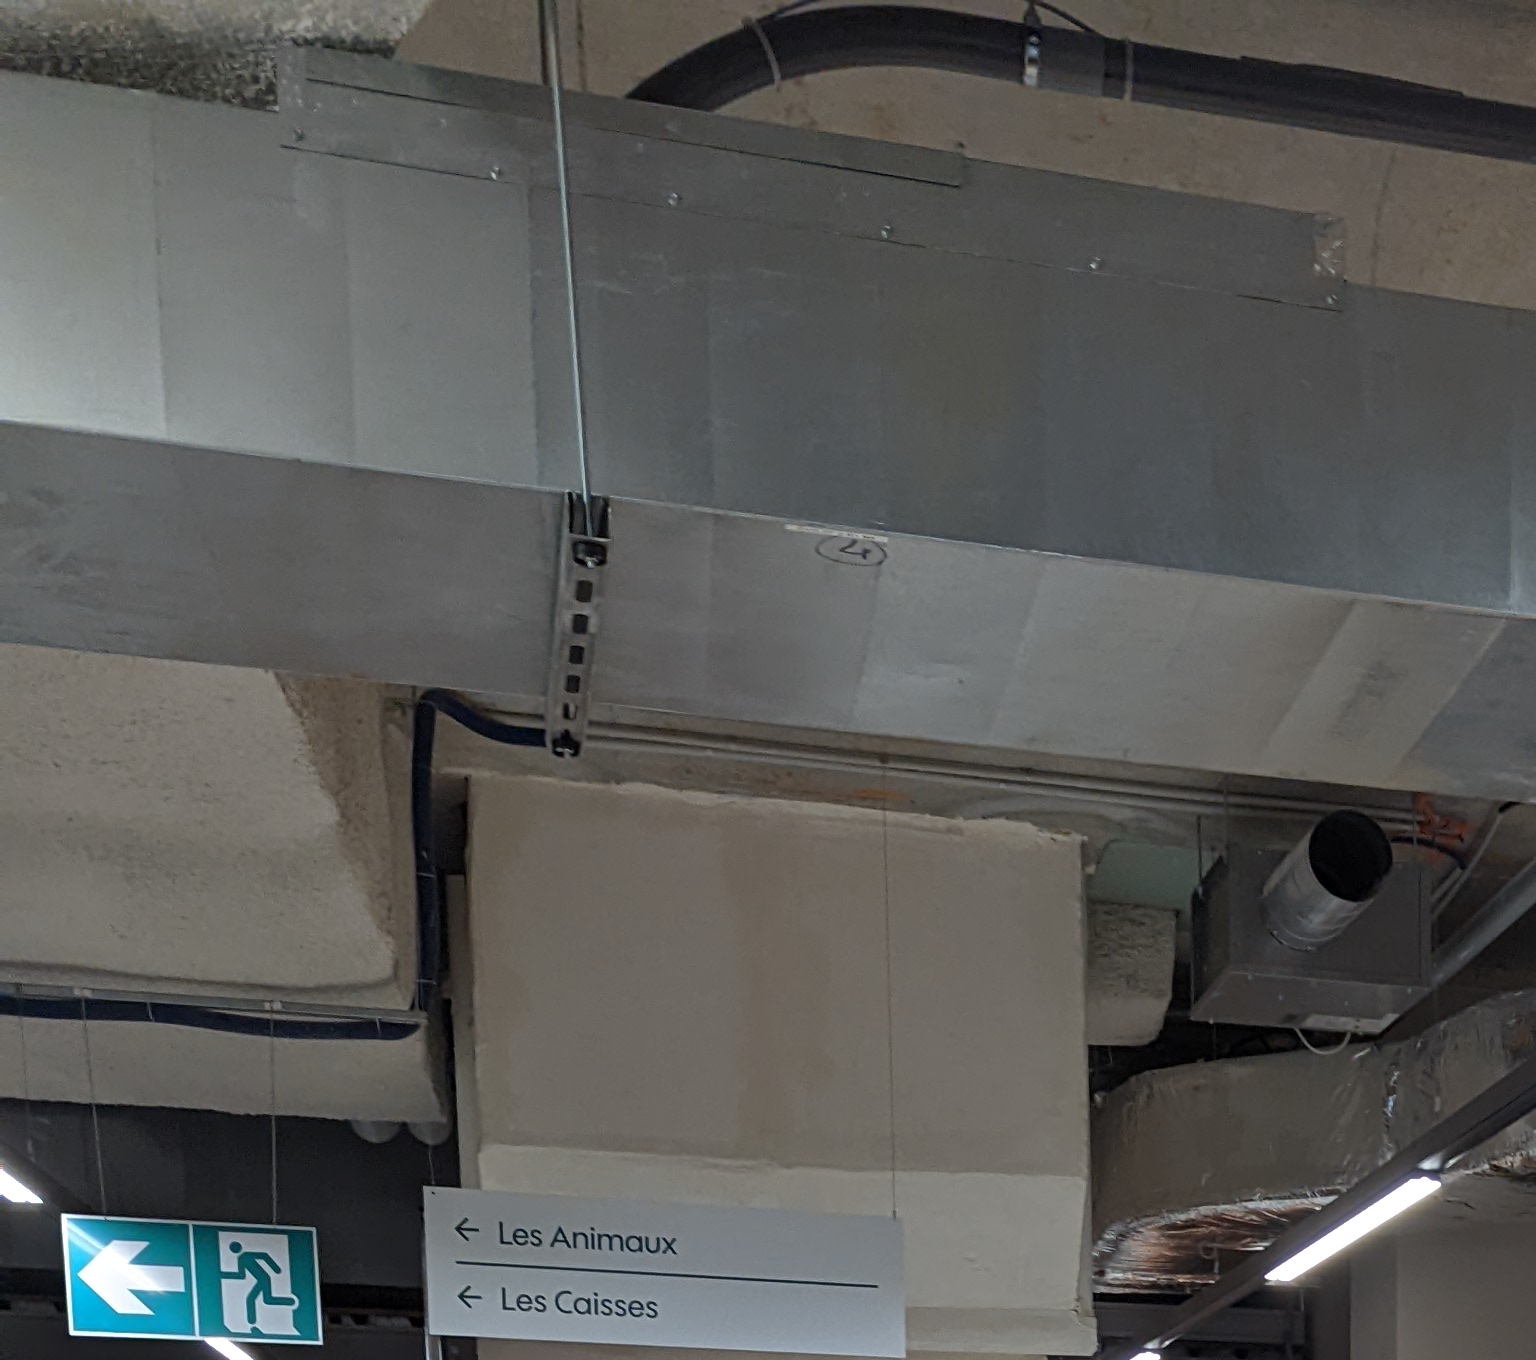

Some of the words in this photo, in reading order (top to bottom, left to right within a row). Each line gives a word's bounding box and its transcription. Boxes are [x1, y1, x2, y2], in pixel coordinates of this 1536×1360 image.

[498, 1220, 543, 1248] Les
[549, 1225, 679, 1256] Animaux
[501, 1286, 548, 1314] Les
[554, 1290, 660, 1320] Caisses
